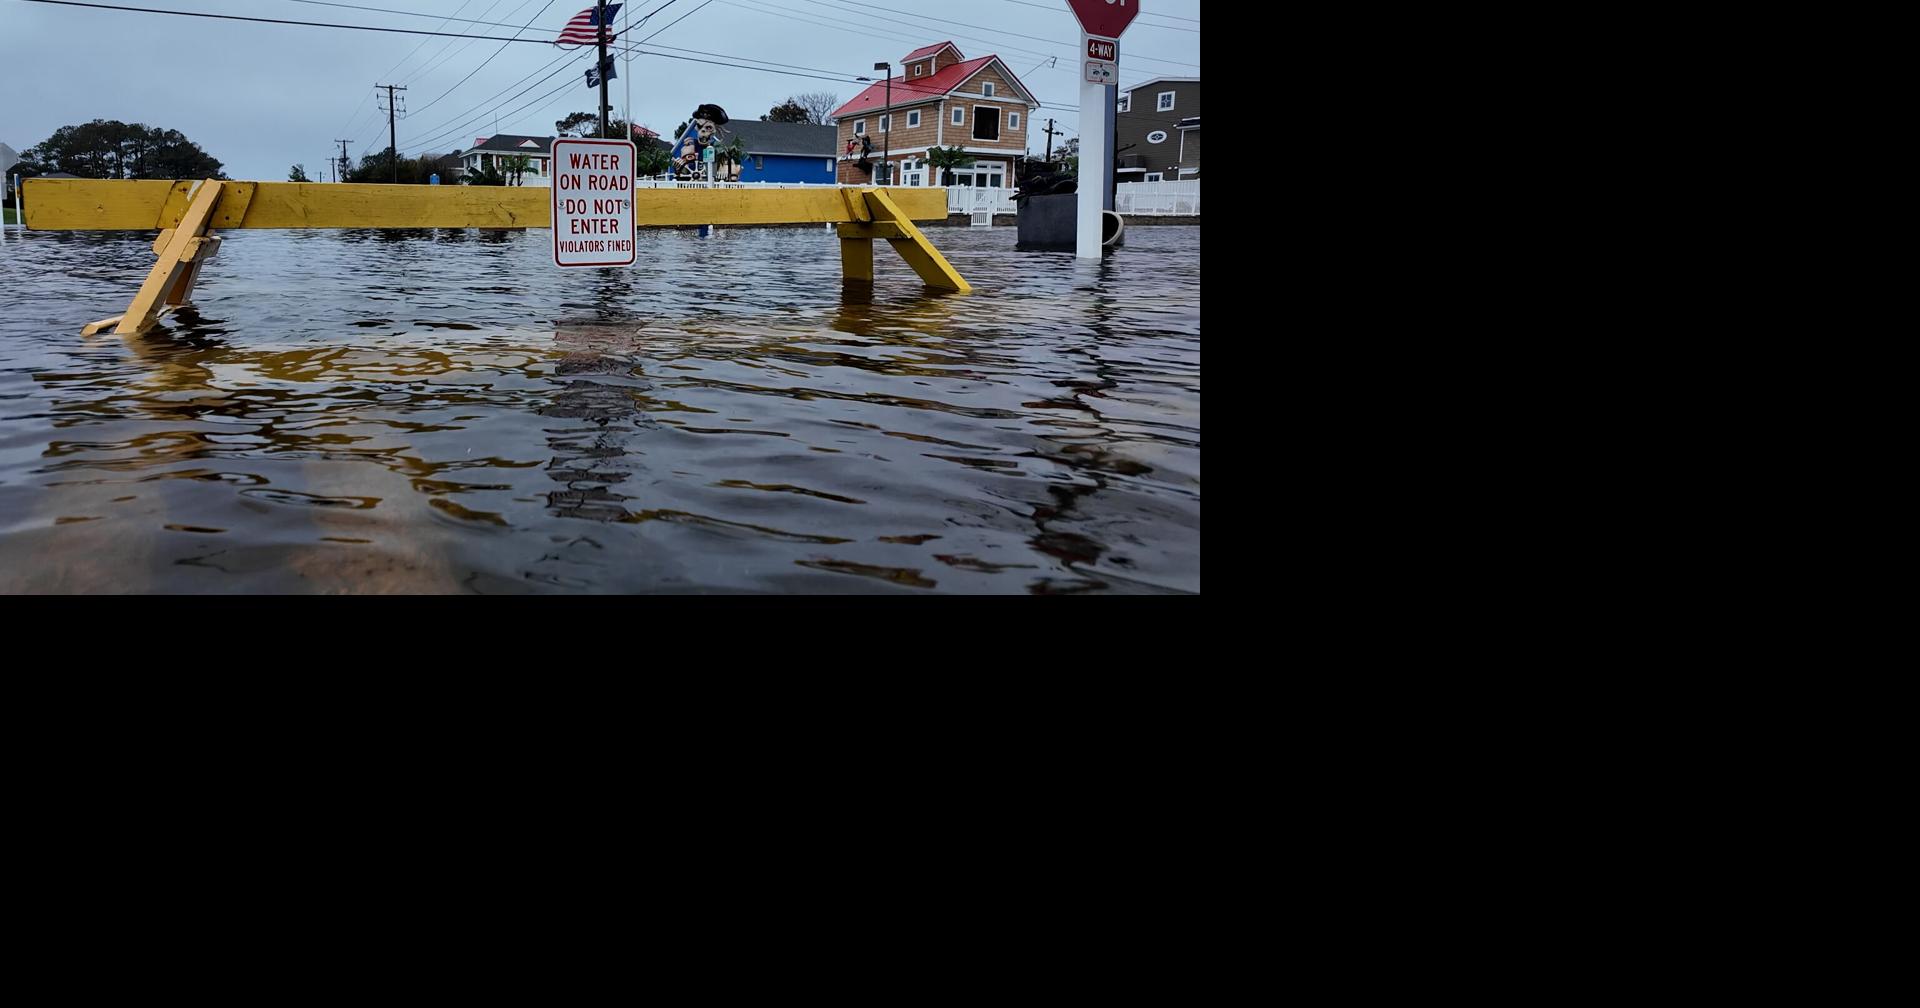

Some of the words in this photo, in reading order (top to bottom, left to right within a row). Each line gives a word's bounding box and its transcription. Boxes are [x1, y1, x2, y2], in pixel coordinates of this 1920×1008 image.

[1090, 43, 1112, 57] 4-WAY
[570, 154, 619, 170] WATER
[560, 174, 581, 190] ON
[589, 175, 628, 190] ROAD
[566, 199, 586, 214] DO
[594, 199, 622, 214] NOT
[571, 219, 619, 234] ENTER
[560, 241, 604, 253] VIOLATORS
[608, 240, 631, 252] FINED
